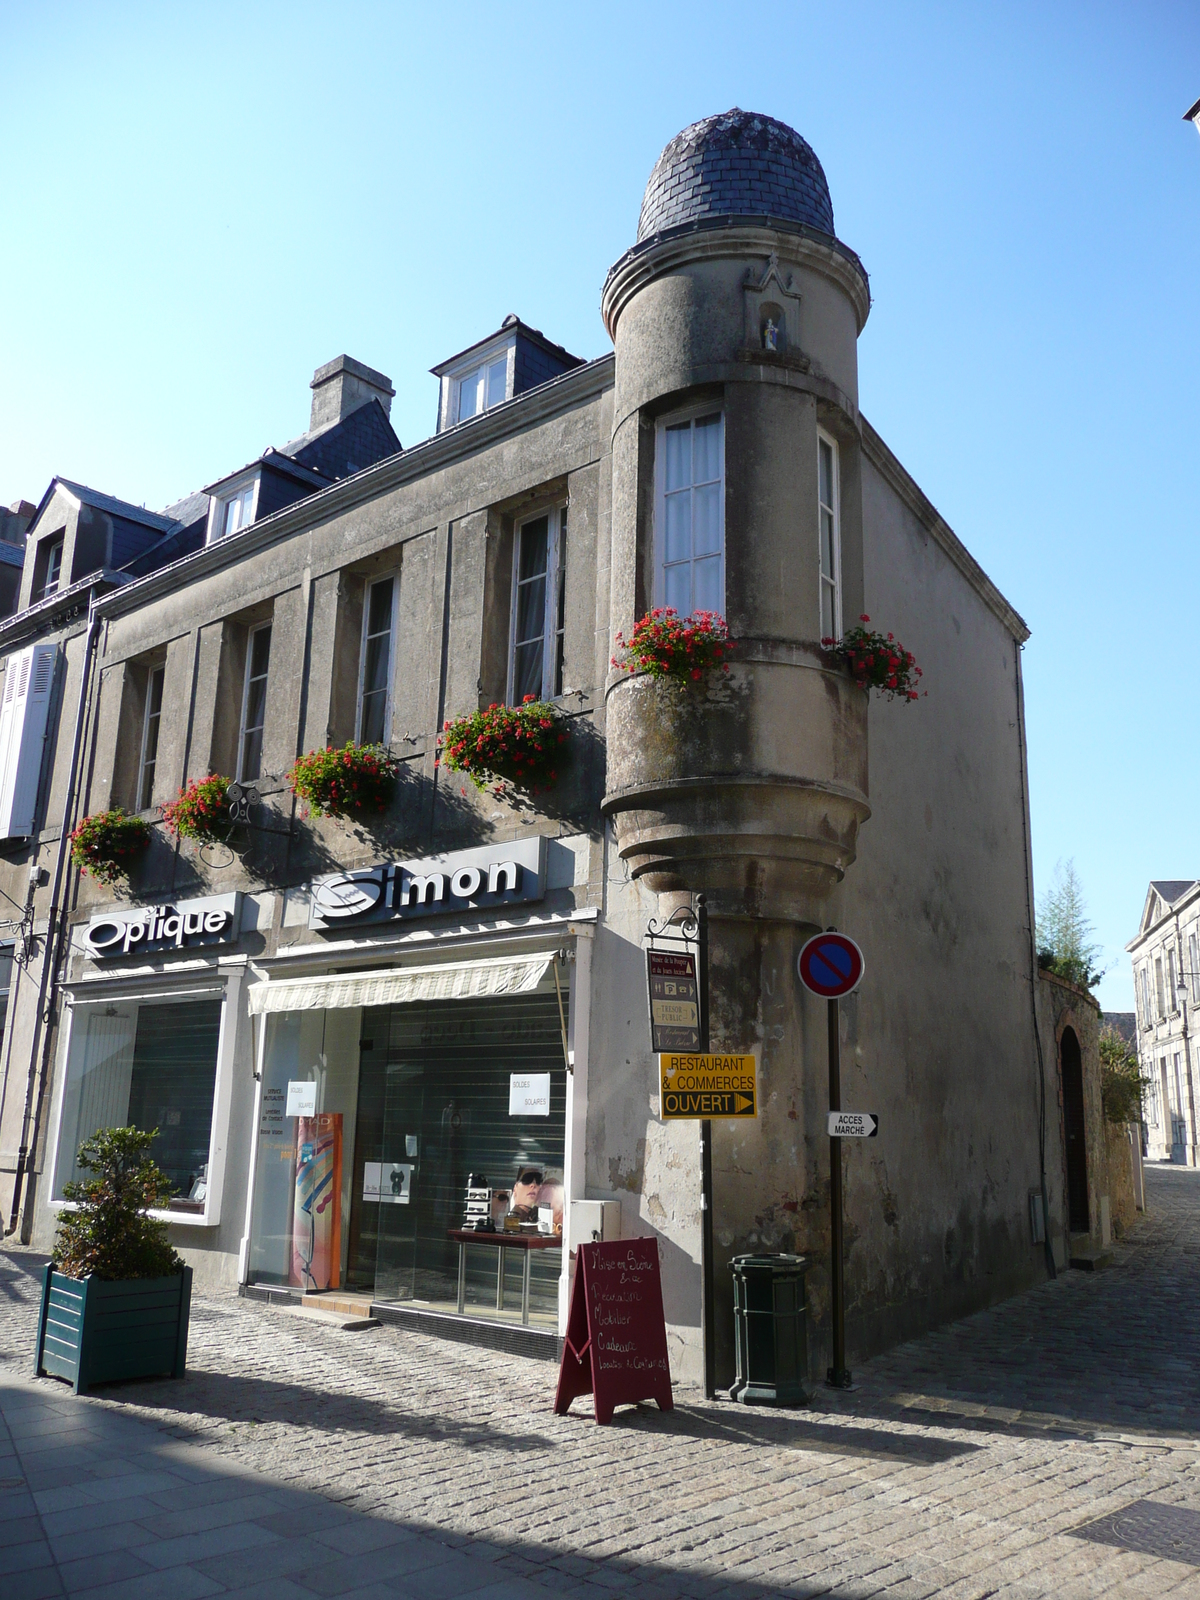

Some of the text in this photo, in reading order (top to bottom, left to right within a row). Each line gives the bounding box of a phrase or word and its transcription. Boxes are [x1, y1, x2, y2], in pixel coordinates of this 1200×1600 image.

[312, 861, 518, 918] Simon
[81, 905, 227, 952] Optique
[661, 1005, 682, 1013] TRESOR
[661, 1013, 682, 1022] PUBLIC
[670, 1057, 745, 1071] RESTAURANT
[662, 1076, 755, 1090] & COMMERCES
[524, 1098, 547, 1106] SOLAIRES
[665, 1094, 731, 1112] OUVERT
[838, 1115, 863, 1125] ACCES
[592, 1248, 616, 1271] Mise
[617, 1261, 628, 1271] en
[594, 1303, 632, 1326] Mobilier
[597, 1332, 637, 1353] Cadeaux
